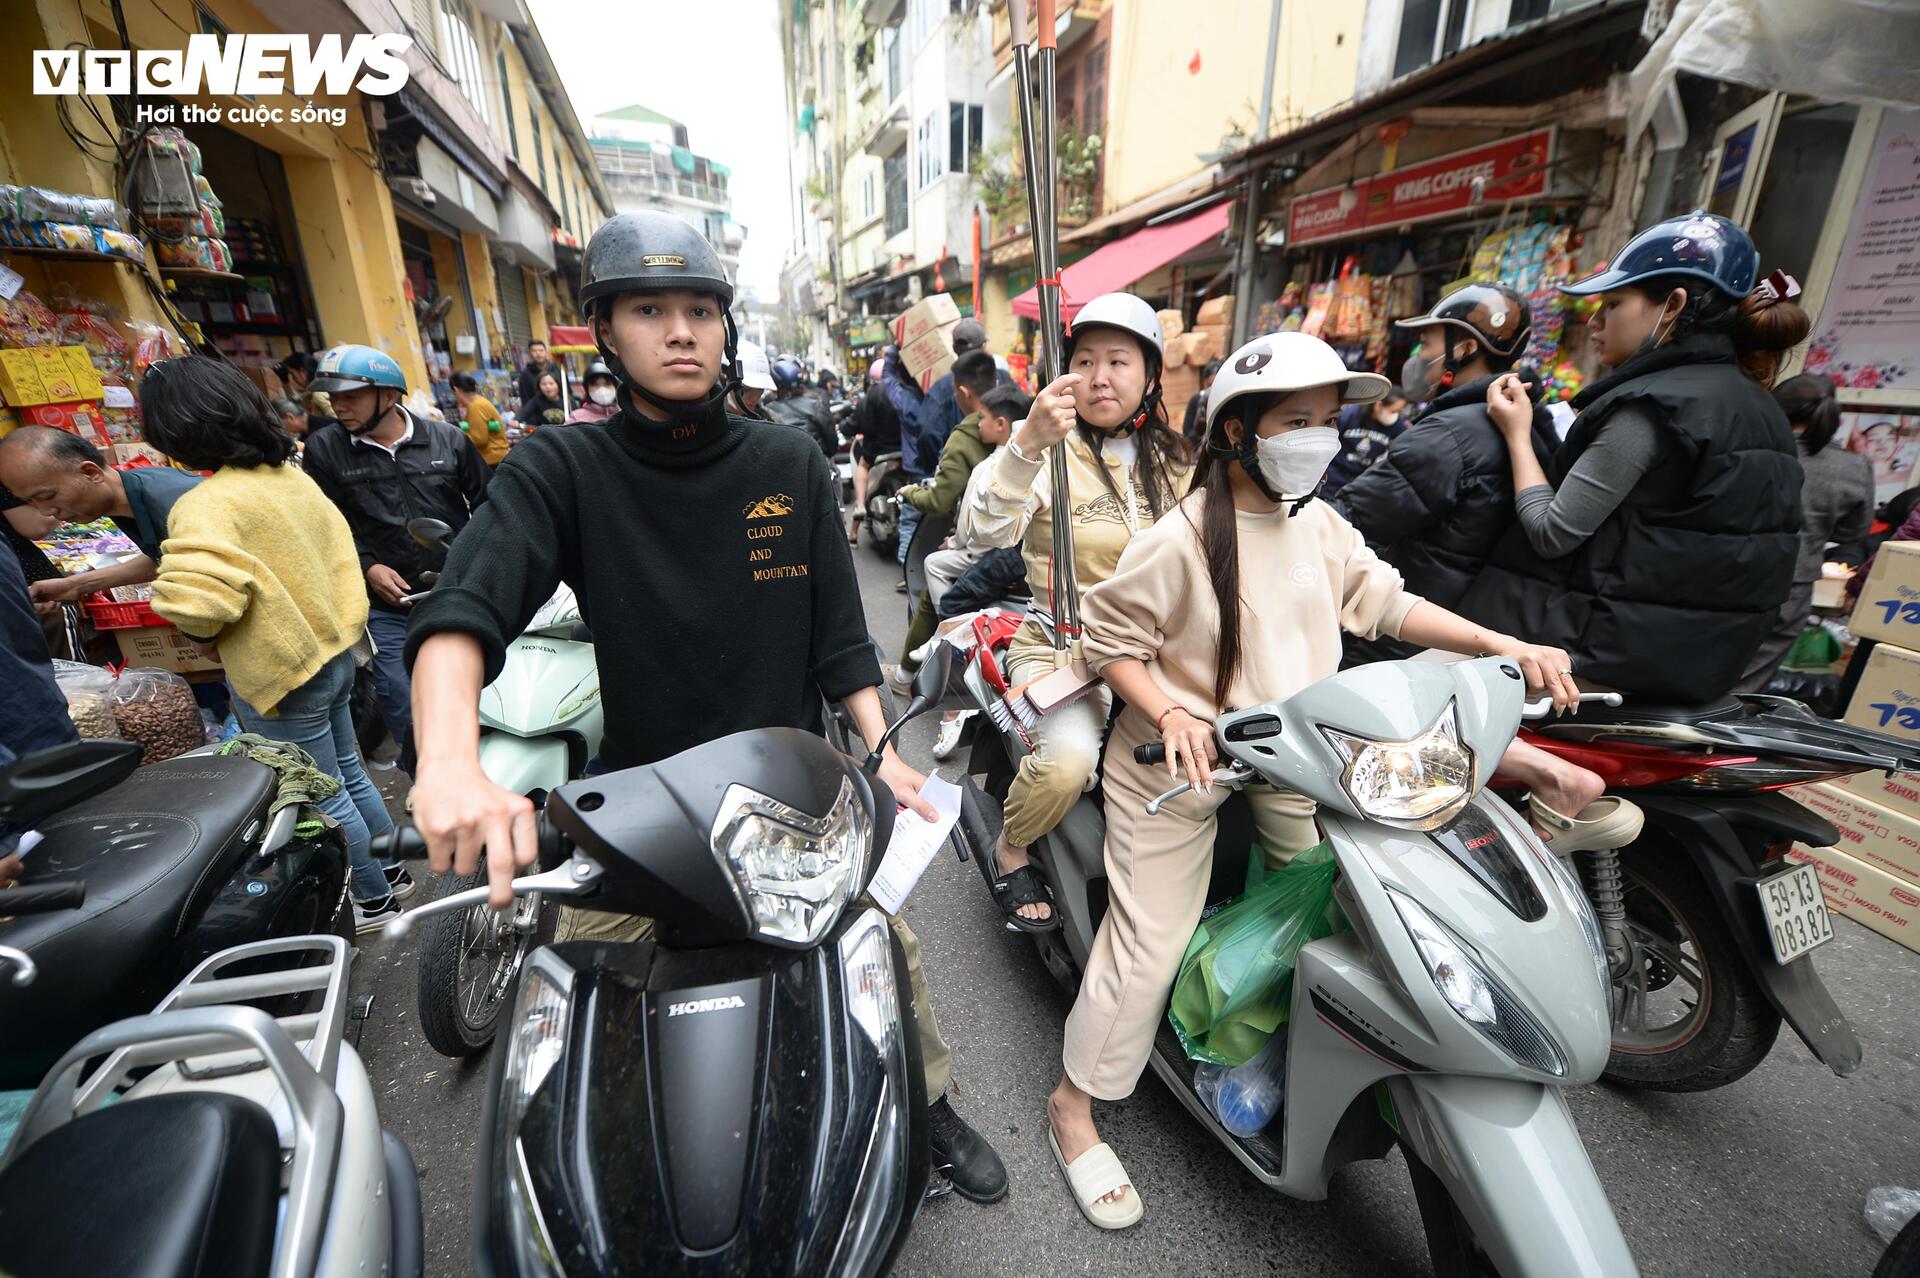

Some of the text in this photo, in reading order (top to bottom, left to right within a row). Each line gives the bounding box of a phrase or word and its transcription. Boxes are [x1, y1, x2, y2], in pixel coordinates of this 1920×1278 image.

[1393, 176, 1432, 204] KING
[1432, 160, 1497, 194] COFFEE
[747, 525, 783, 540] CLOUD
[749, 548, 773, 562] AND
[753, 564, 808, 582] MOUNTAIN
[521, 644, 557, 654] HONDA
[1825, 865, 1859, 888] WHIZ
[1768, 871, 1814, 917] 59-X3
[1854, 896, 1881, 914] MIXED
[1882, 909, 1909, 927] FRUIT
[1774, 905, 1830, 957] 083.82
[668, 996, 746, 1017] HONDA
[1315, 984, 1404, 1048] SPORT
